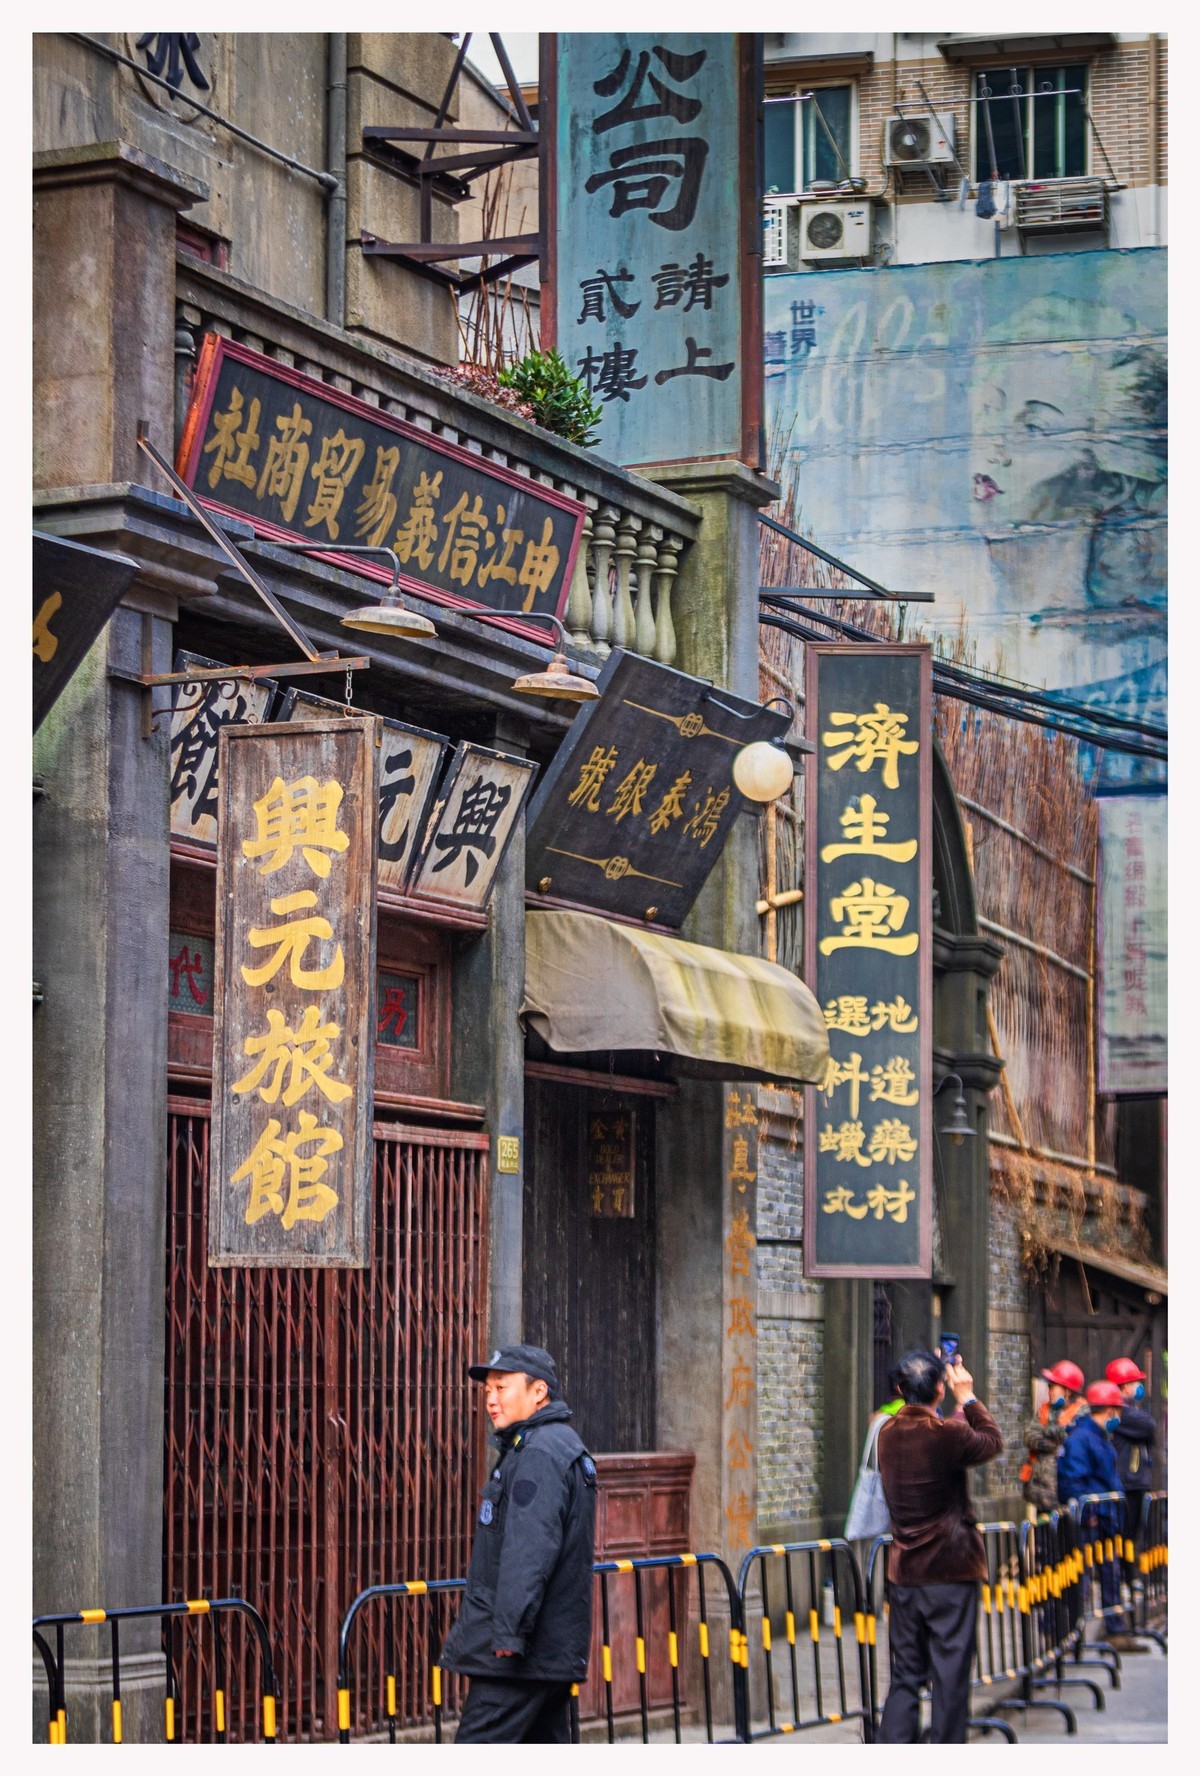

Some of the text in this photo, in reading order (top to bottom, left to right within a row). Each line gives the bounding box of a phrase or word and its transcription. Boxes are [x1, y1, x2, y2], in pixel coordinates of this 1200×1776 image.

[585, 45, 709, 231] 公司
[577, 268, 648, 403] 貳樓
[651, 253, 735, 386] 請上
[789, 299, 818, 356] 世界
[568, 744, 731, 848] 鴻泰銀號
[819, 703, 920, 957] 濟生堂
[230, 776, 353, 1230] 興元旅館
[501, 1141, 519, 1159] 265
[868, 995, 919, 1223] 地道藥材
